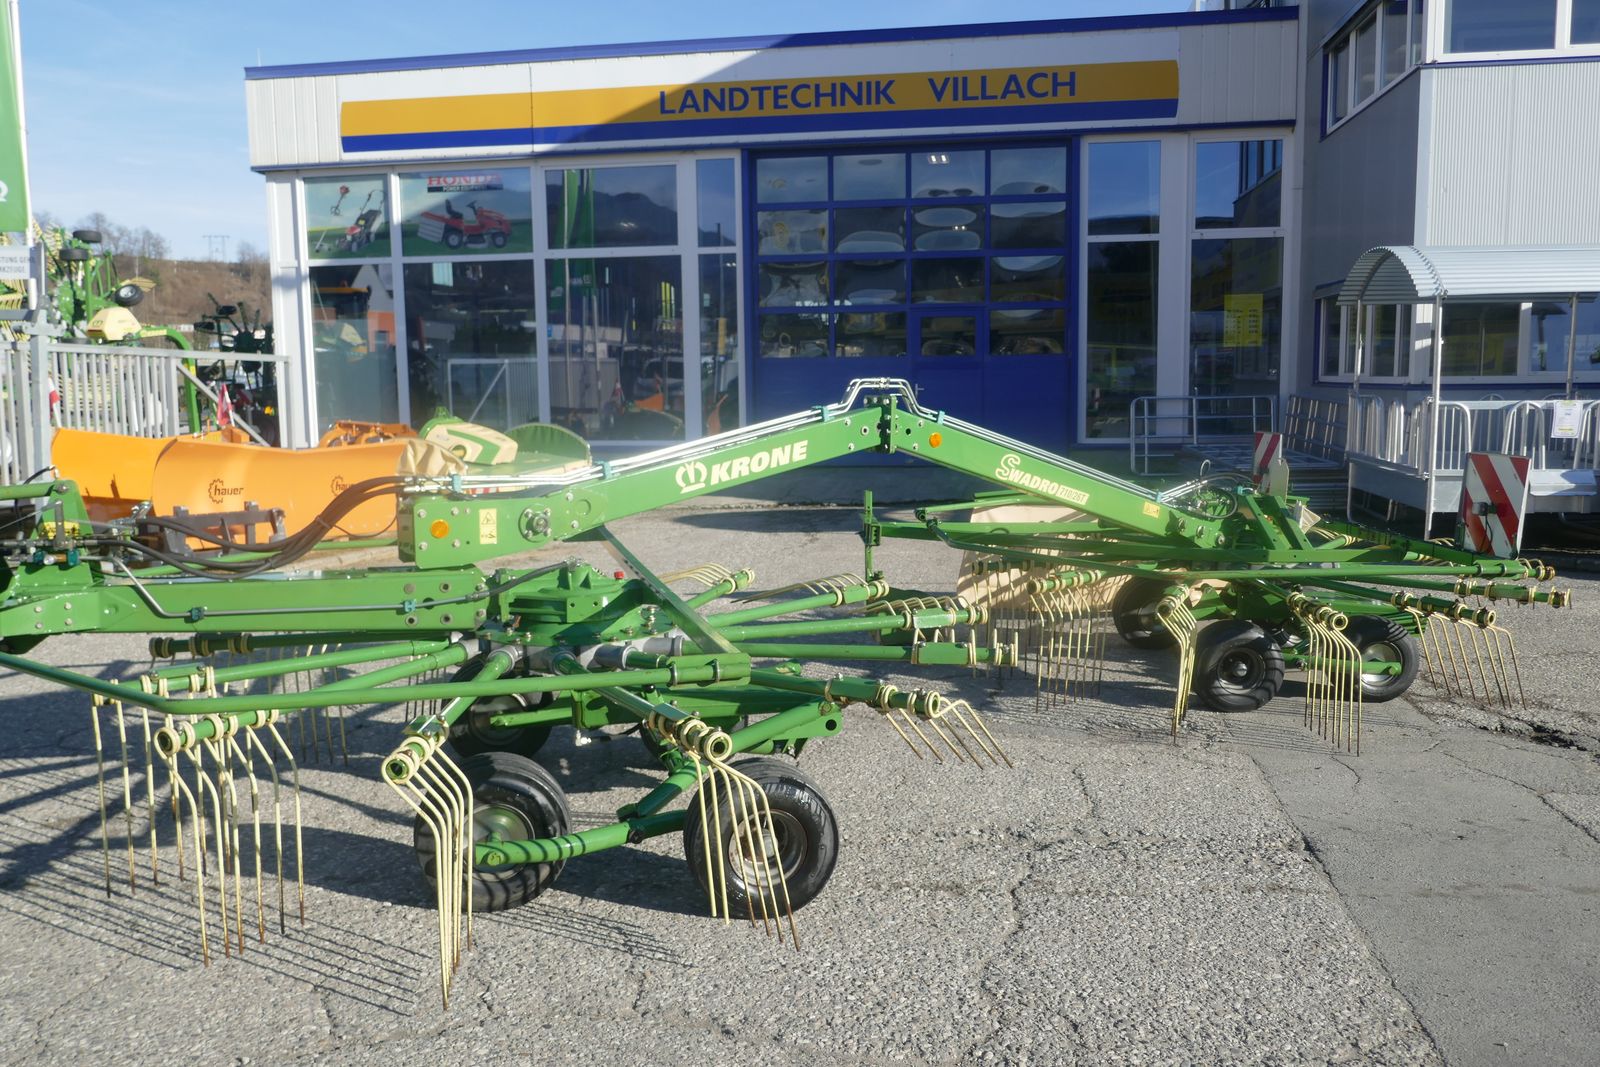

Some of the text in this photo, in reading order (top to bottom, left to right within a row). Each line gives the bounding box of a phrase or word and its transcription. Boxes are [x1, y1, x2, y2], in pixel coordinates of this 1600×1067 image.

[659, 71, 1076, 115] LANDTECHNIK VILLACH
[710, 440, 809, 486] KRONE
[995, 453, 1059, 495] SWADRO
[214, 485, 245, 496] hauer
[335, 480, 352, 492] hau
